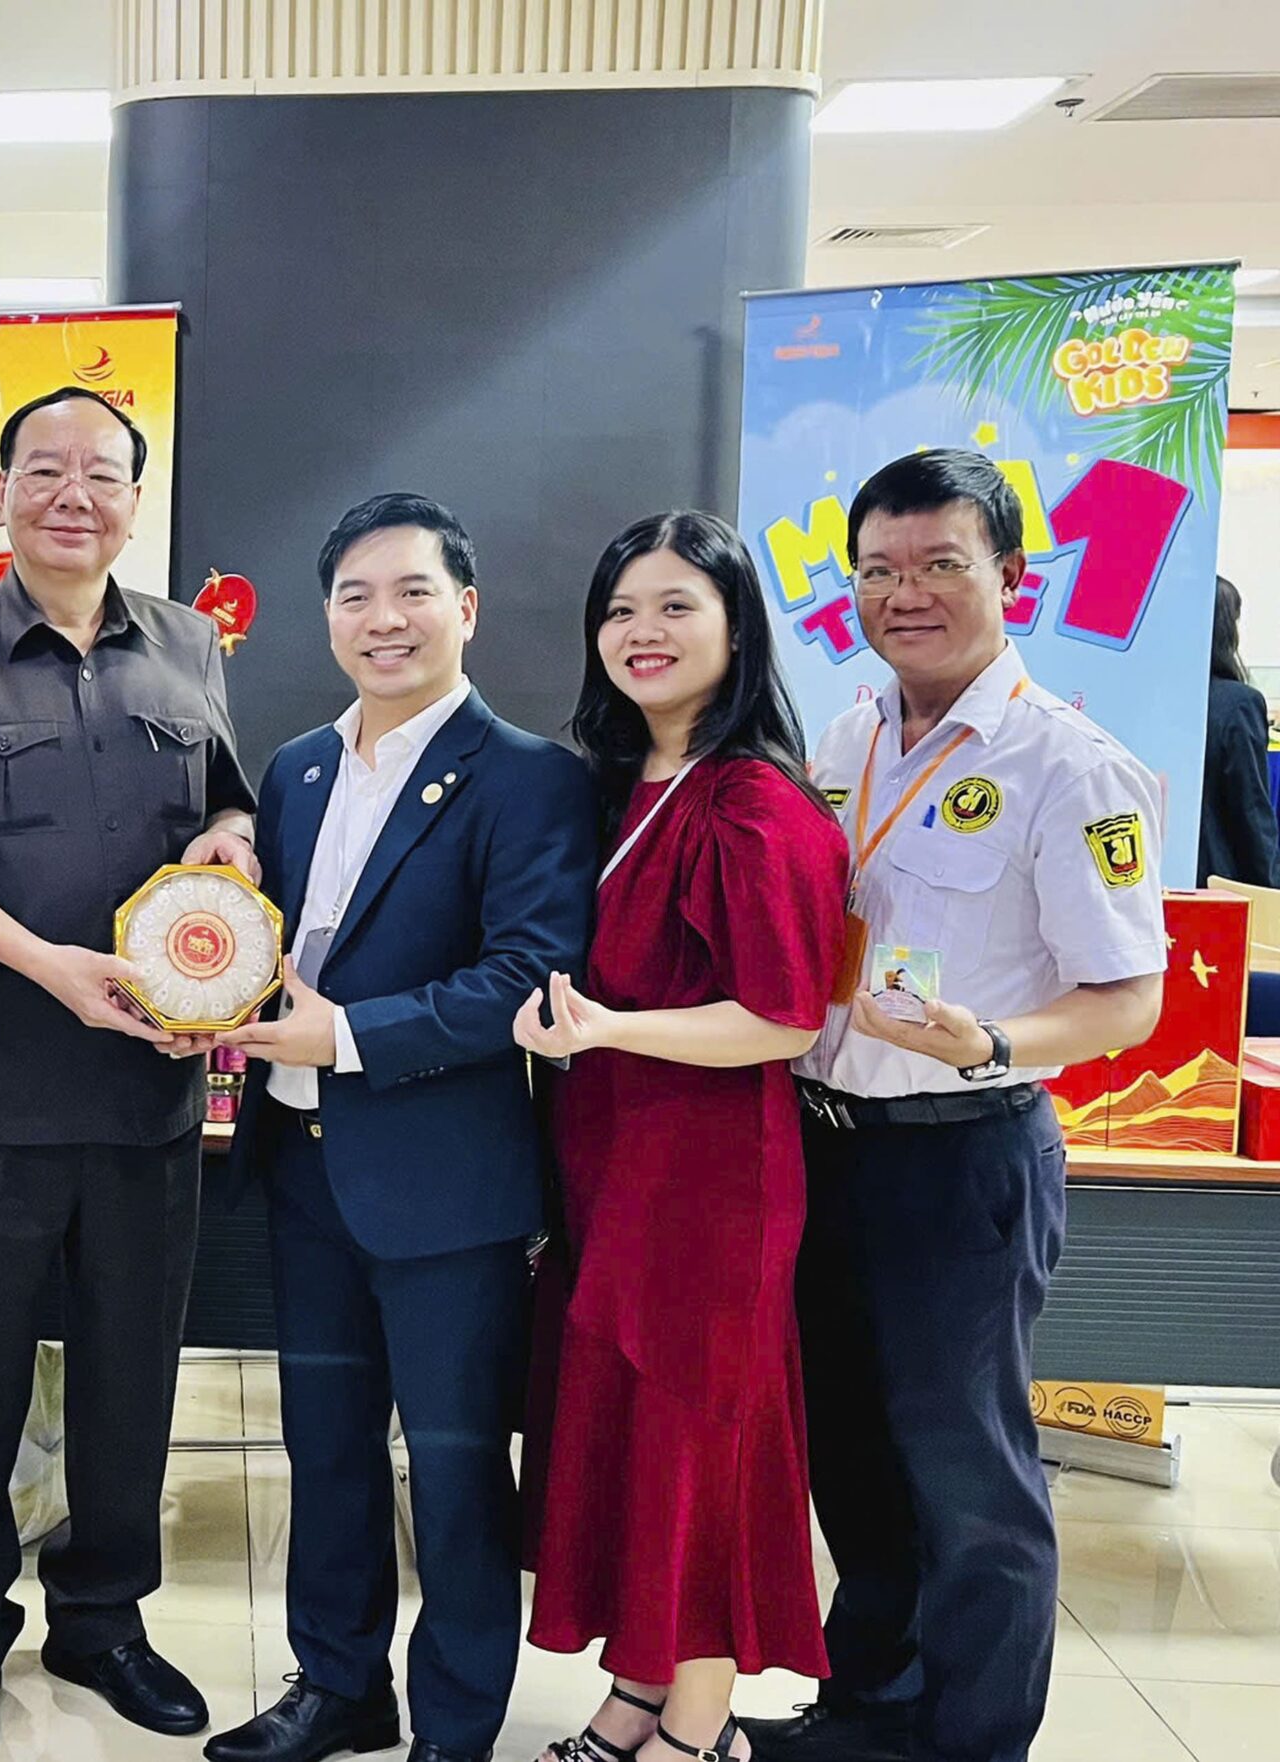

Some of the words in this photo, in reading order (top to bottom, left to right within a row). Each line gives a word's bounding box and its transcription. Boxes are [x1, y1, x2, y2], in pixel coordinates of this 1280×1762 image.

[1069, 365, 1168, 415] KIDS
[1049, 458, 1190, 642] 1
[1103, 1409, 1153, 1426] HACCP
